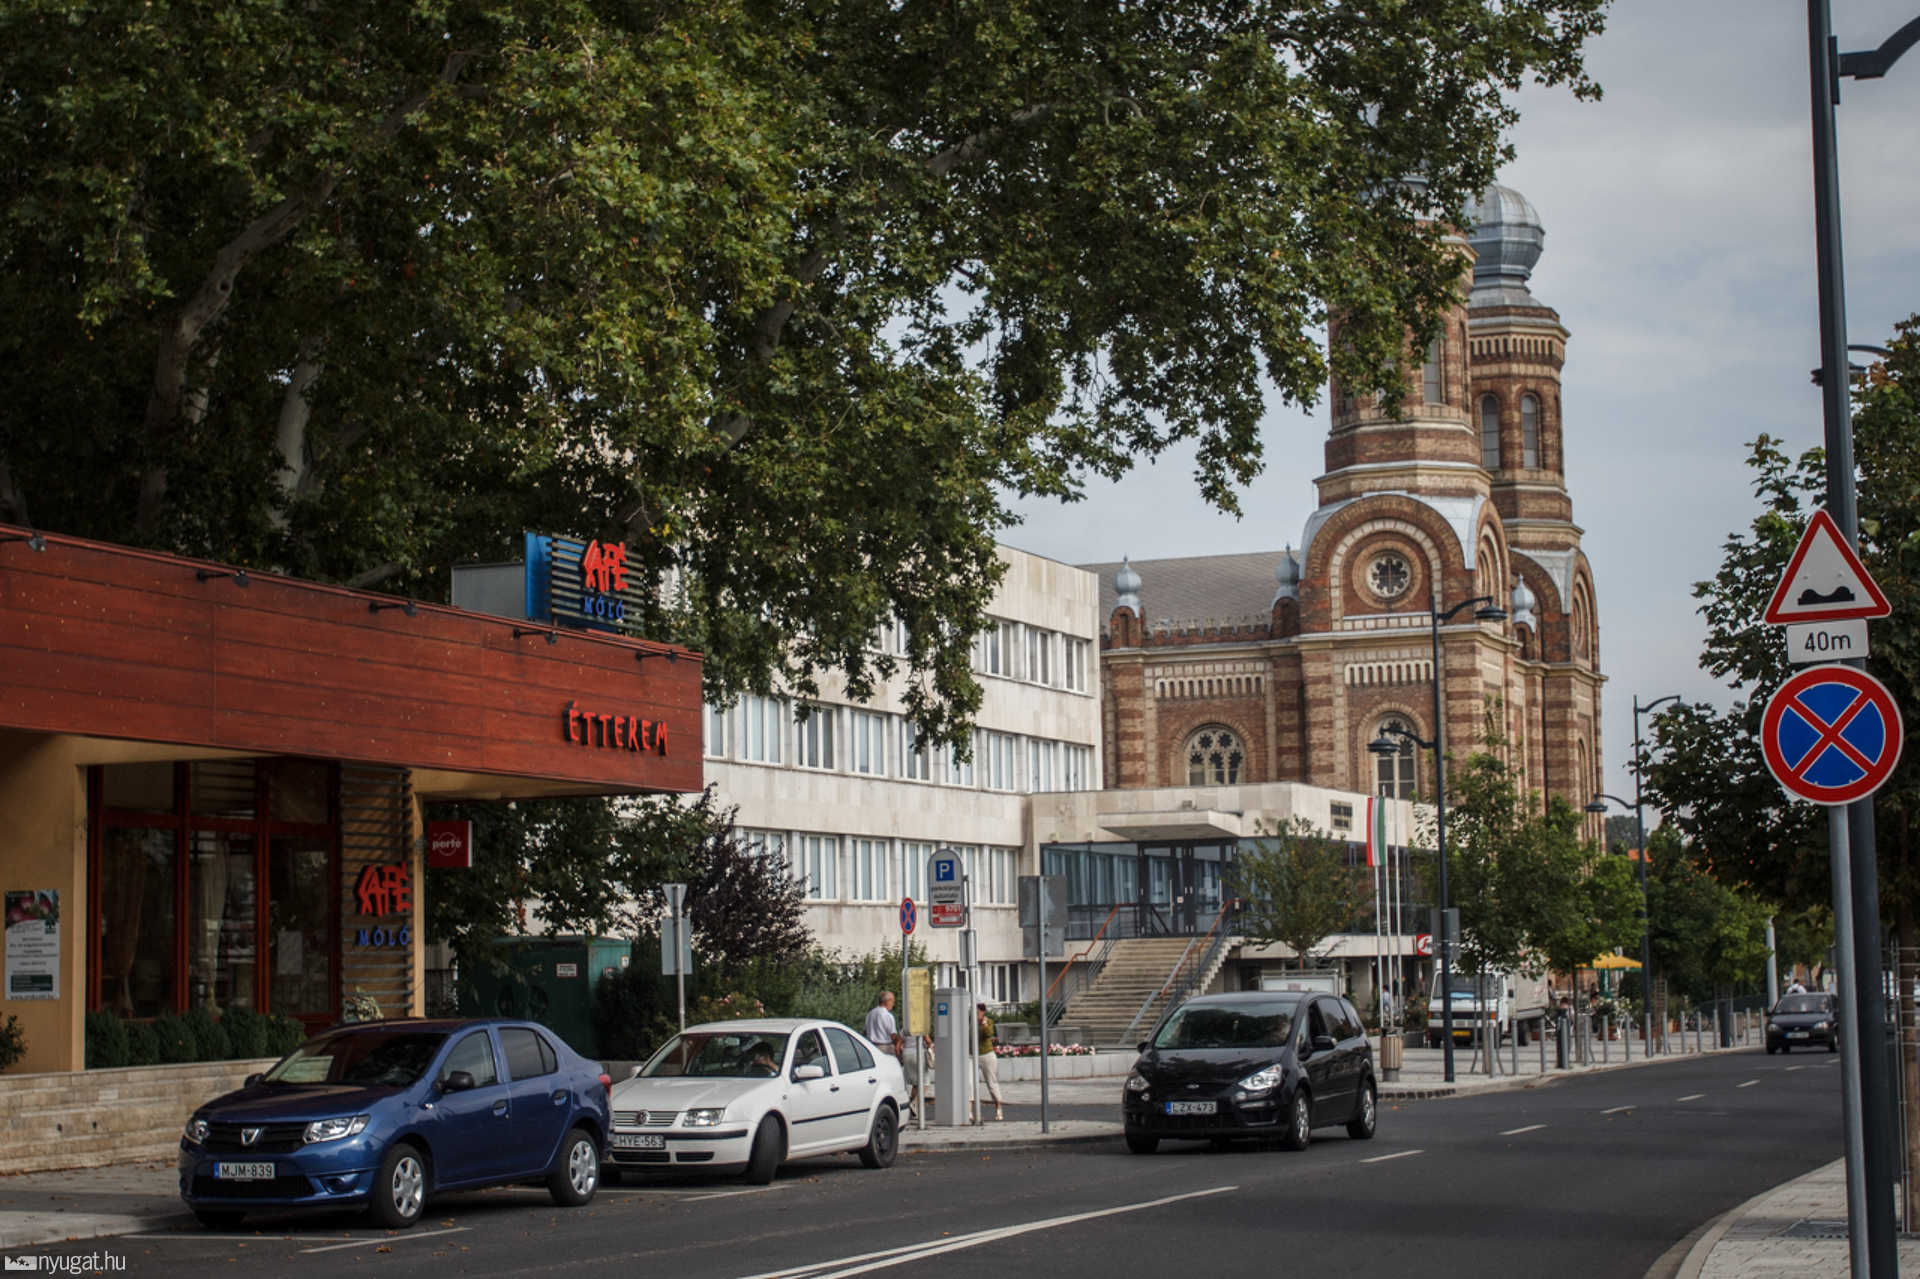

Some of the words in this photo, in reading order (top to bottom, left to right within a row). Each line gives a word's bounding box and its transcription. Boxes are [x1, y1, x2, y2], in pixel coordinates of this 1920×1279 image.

[583, 595, 625, 619] MÓLÓ
[1804, 630, 1852, 652] 40m
[565, 700, 669, 756] ÉTTEREM
[939, 863, 951, 880] P
[358, 924, 409, 947] MÓLÓ
[221, 1164, 273, 1177] MJM-839
